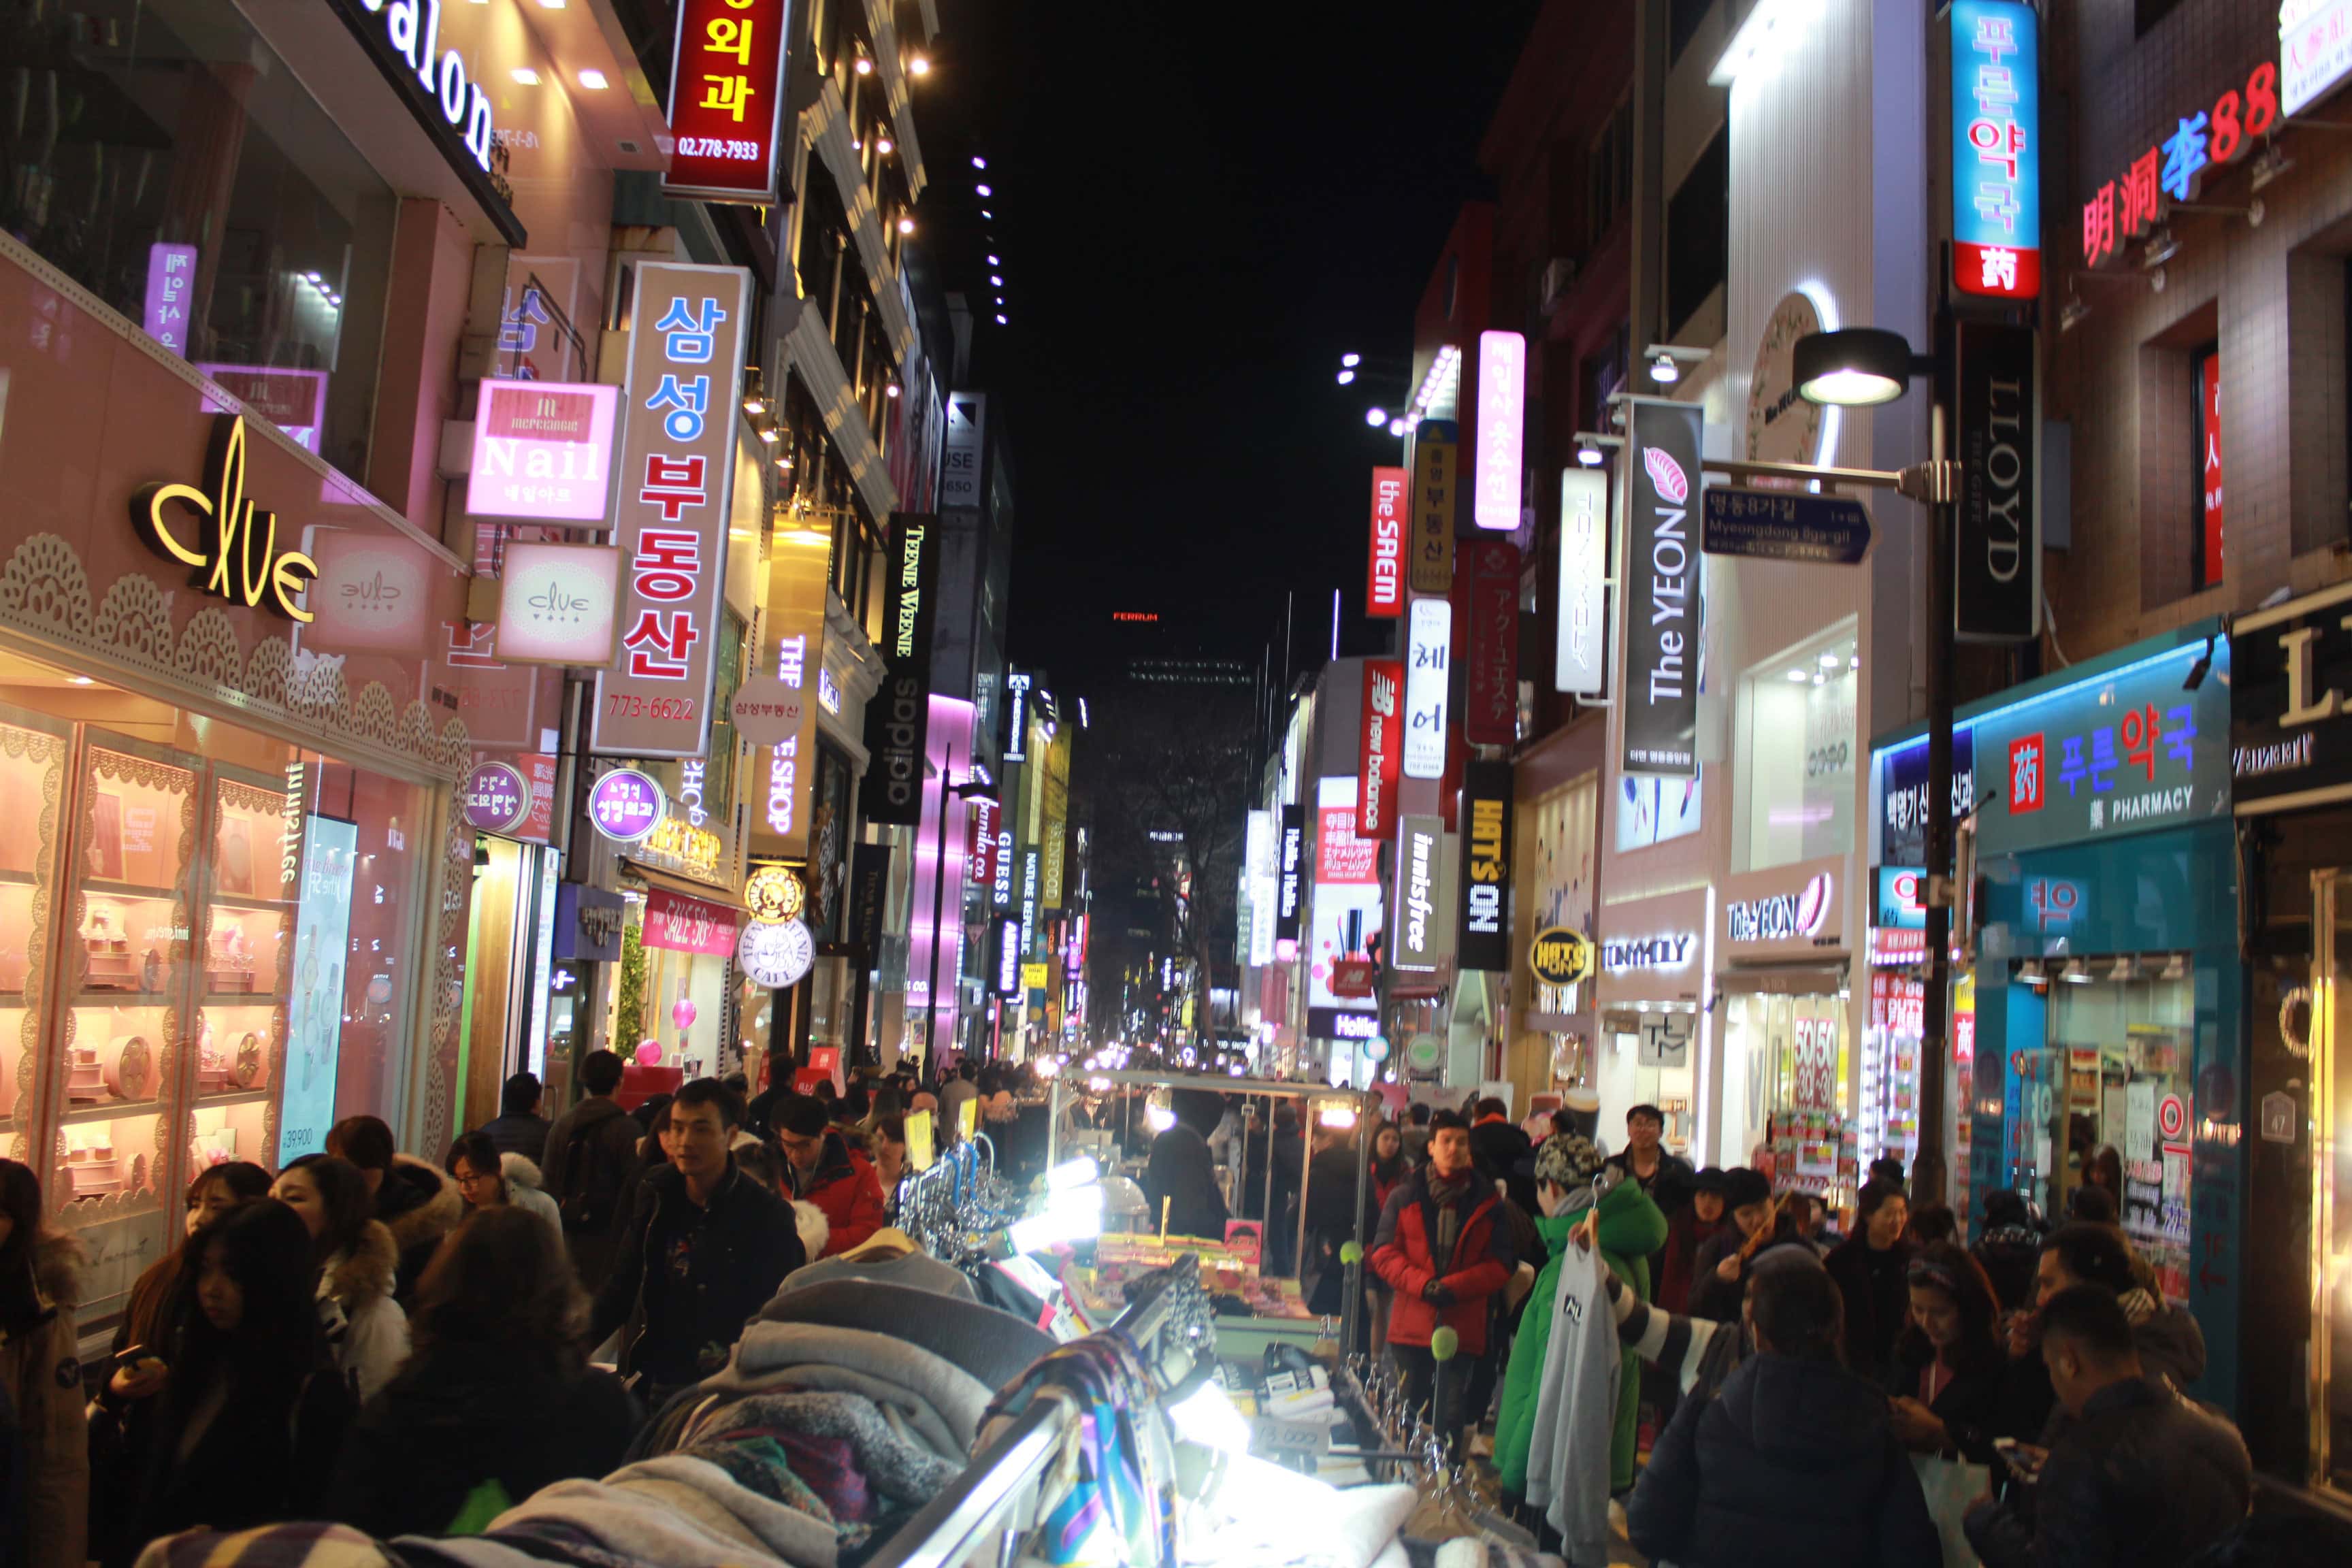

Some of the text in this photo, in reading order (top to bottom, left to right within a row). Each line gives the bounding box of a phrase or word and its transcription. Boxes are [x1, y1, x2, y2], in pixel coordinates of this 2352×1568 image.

[359, 0, 491, 172] alon
[700, 0, 755, 123] 외과
[679, 137, 758, 161] 02.778-7933
[1967, 17, 2025, 235] 푸른약국
[1979, 248, 2016, 291] 药
[479, 439, 600, 481] Nail
[623, 297, 727, 680] 삼성부동산
[1987, 377, 2020, 582] LLOYD
[1374, 480, 1400, 604] the SAEM
[1709, 519, 1799, 541] Myeongdong
[1650, 506, 1687, 706] The YEON
[610, 694, 694, 720] 773-6622
[735, 702, 798, 719] 삼성부동산
[883, 679, 917, 806] adidas
[2058, 702, 2198, 798] 푸른약국
[767, 760, 796, 834] SHOP
[1366, 715, 1384, 830] new balance
[2013, 747, 2039, 806] 药
[2112, 785, 2194, 822] PHARMACY
[994, 832, 1012, 904] GUESS
[1020, 852, 1036, 956] NATURE REPUBLIC
[1281, 828, 1300, 917] Holika Holika
[1407, 832, 1433, 953] innisfree
[1727, 896, 1797, 939] The YEON
